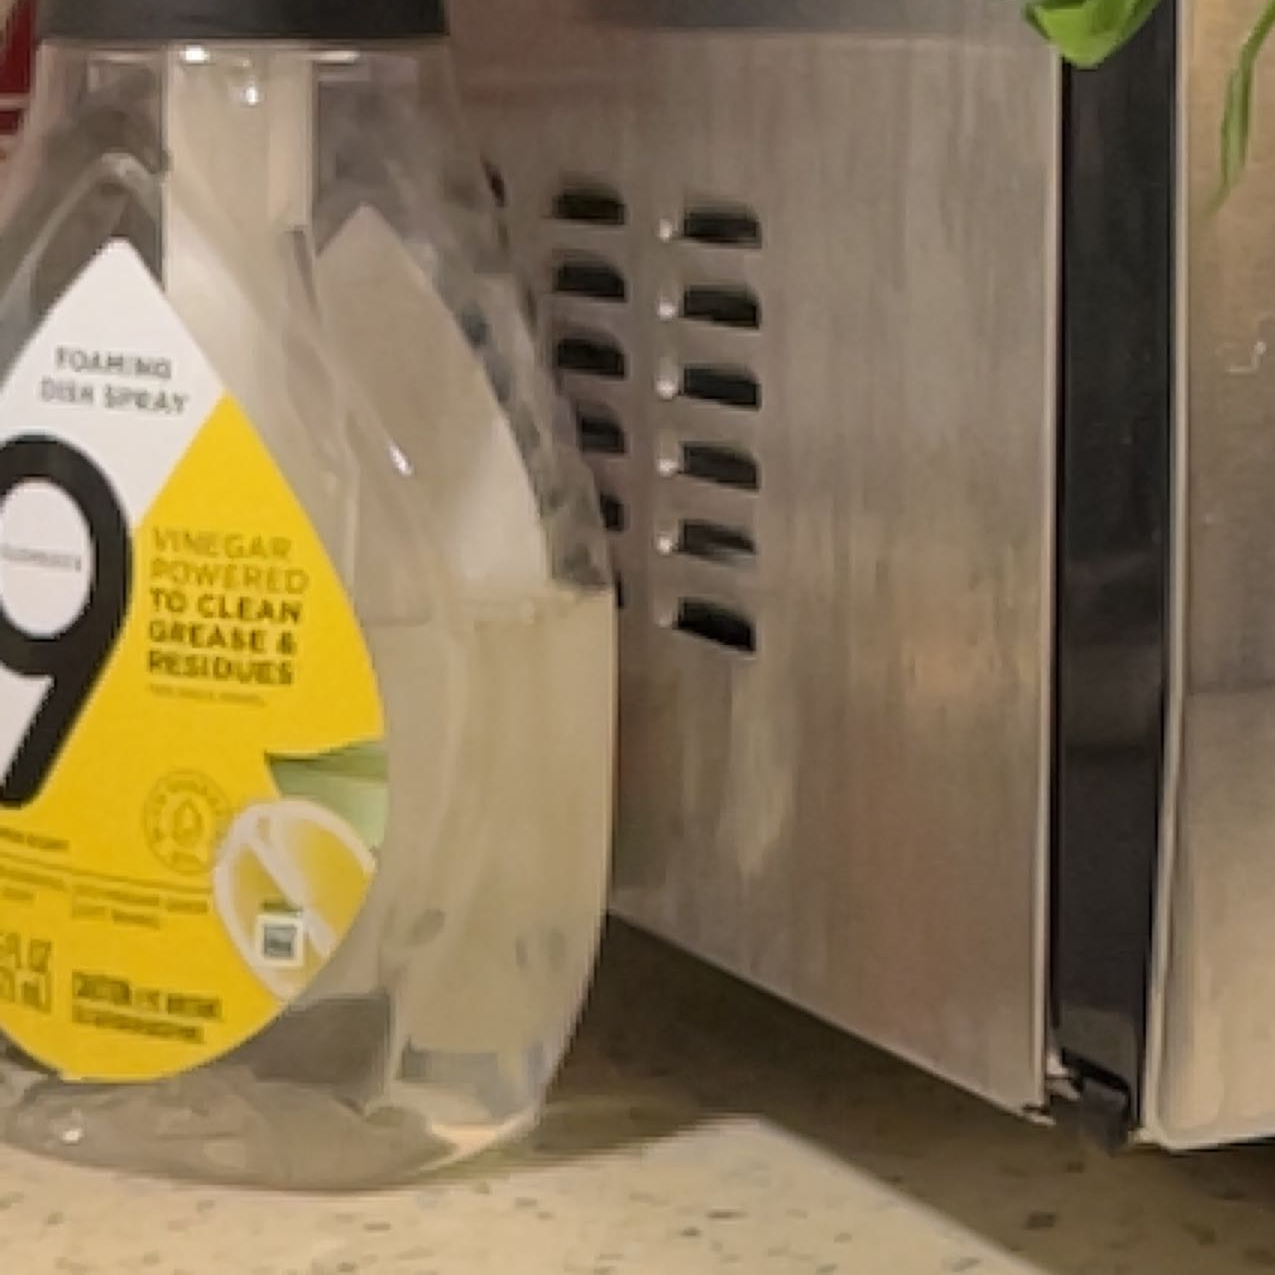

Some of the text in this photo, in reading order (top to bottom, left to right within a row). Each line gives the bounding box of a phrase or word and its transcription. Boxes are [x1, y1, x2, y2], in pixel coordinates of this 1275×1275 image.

[56, 345, 172, 380] FOAMING
[104, 382, 189, 415] SPRAY
[152, 528, 292, 559] VINEGAR
[151, 557, 310, 595] POWERED
[0, 432, 133, 809] 9
[150, 587, 304, 625] TO CLEAN
[149, 620, 269, 655] GREASE
[148, 649, 295, 686] RESIDUES
